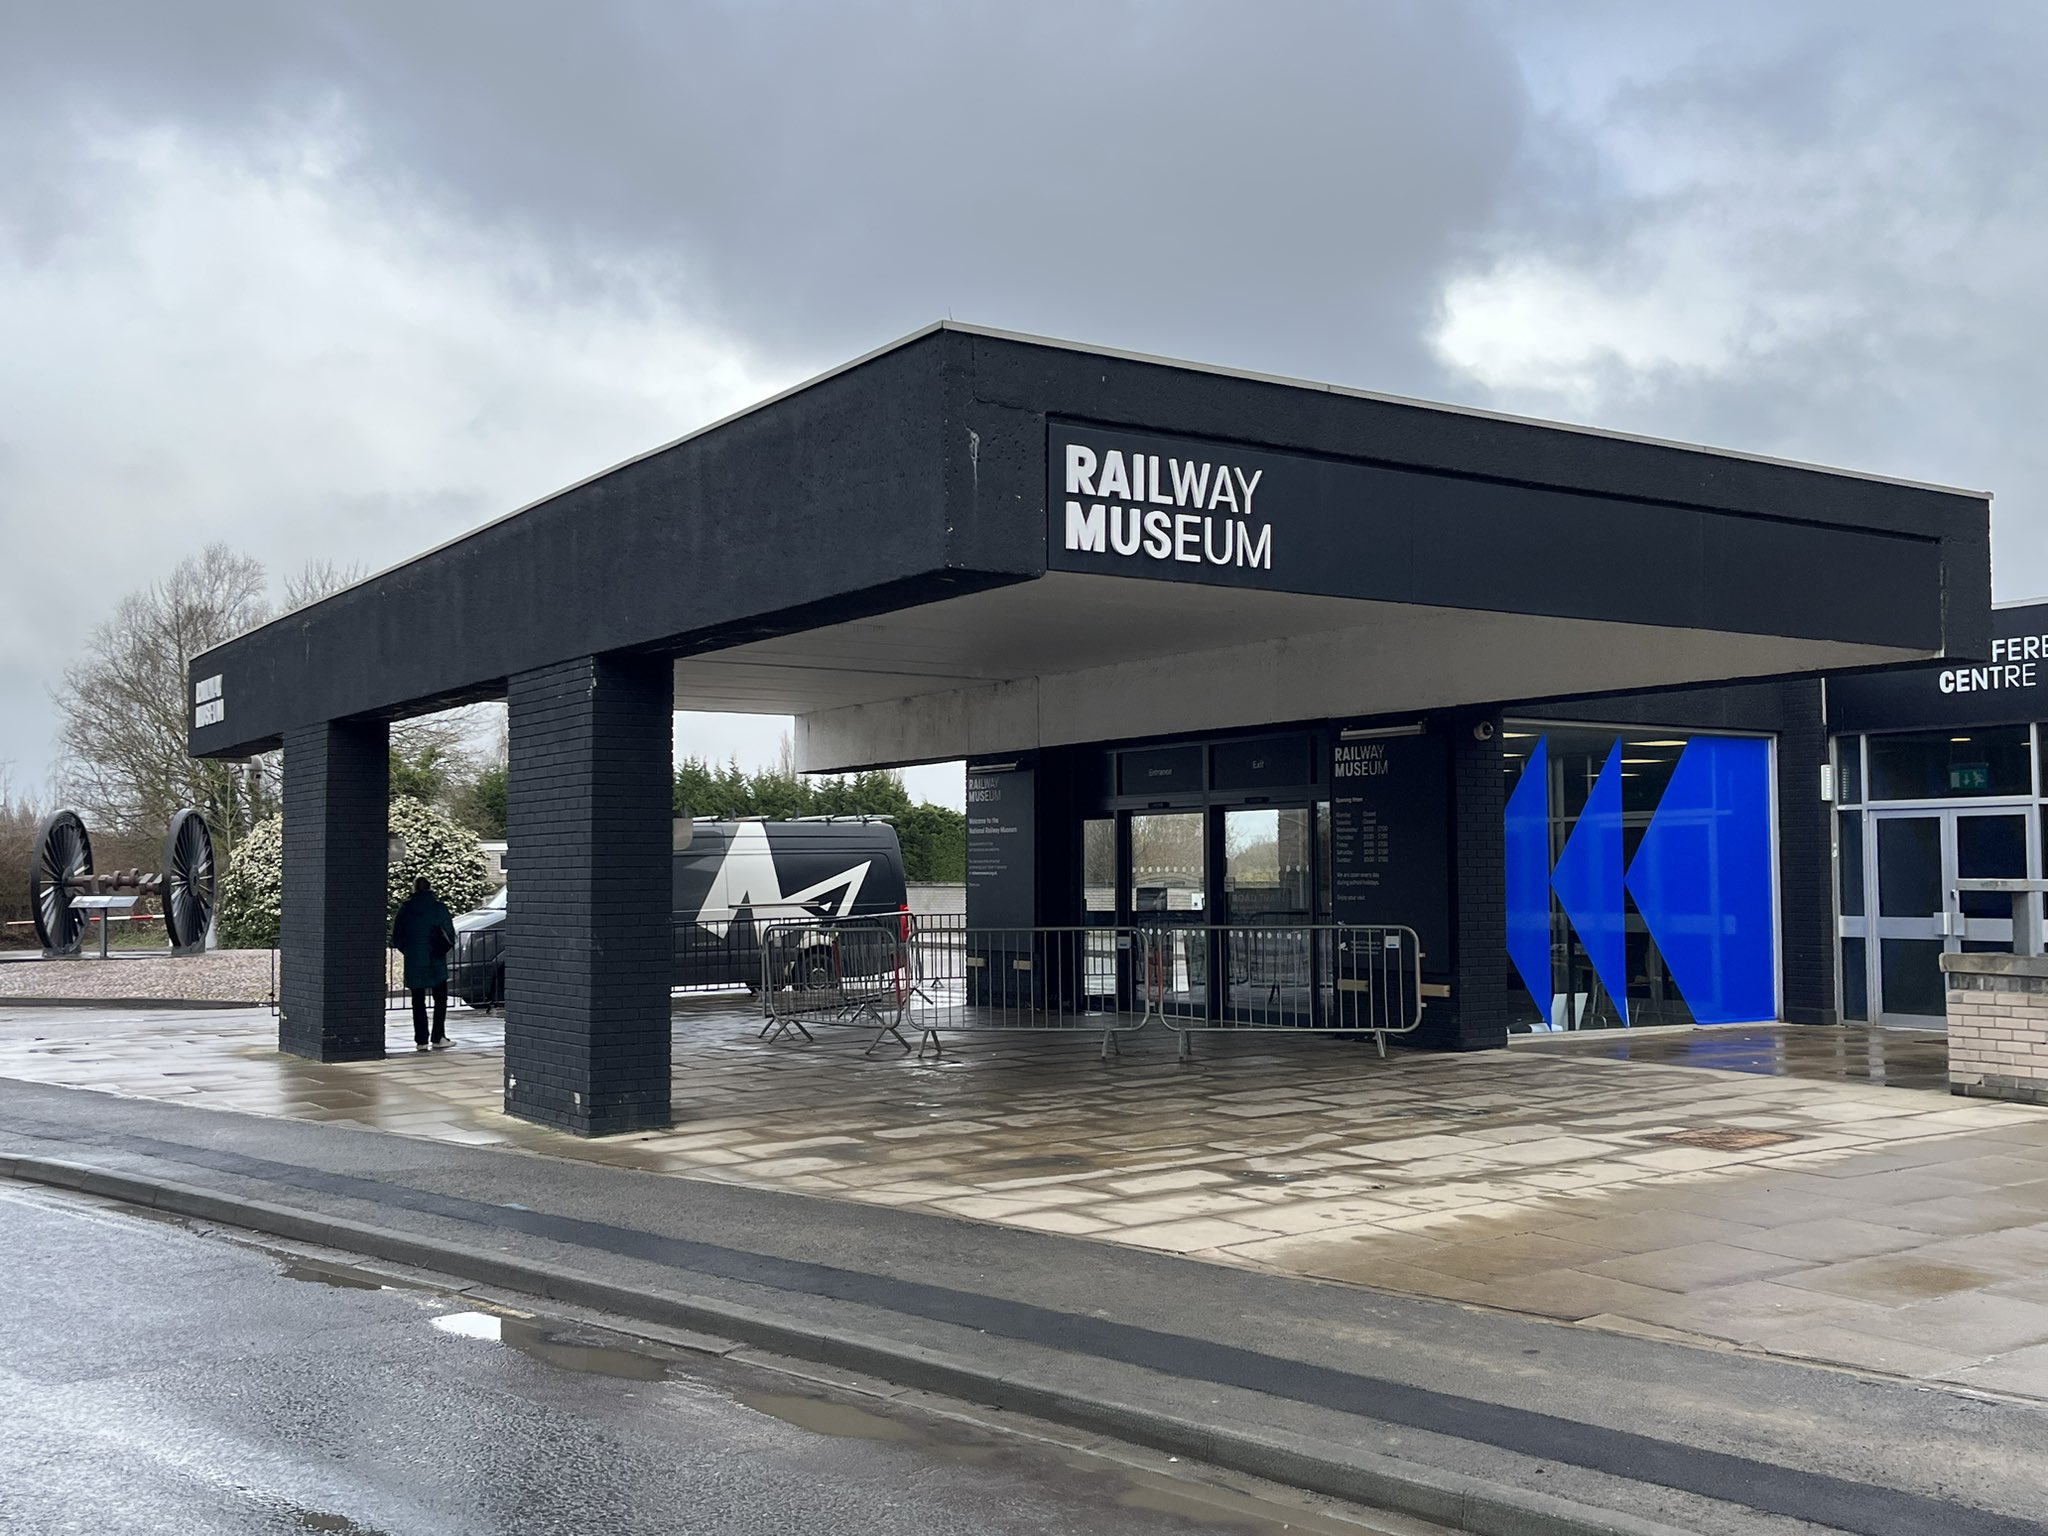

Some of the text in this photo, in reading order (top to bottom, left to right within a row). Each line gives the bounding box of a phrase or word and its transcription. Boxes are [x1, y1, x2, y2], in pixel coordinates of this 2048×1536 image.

[1066, 444, 1263, 514] RAILWAY
[1065, 501, 1272, 570] MUSEUM
[1939, 663, 2037, 694] CENTRE
[1335, 744, 1385, 762] RAILWAY
[1335, 760, 1389, 777] MUSEUM
[969, 777, 999, 790] RAILWAY
[969, 790, 1001, 803] MUSEUM
